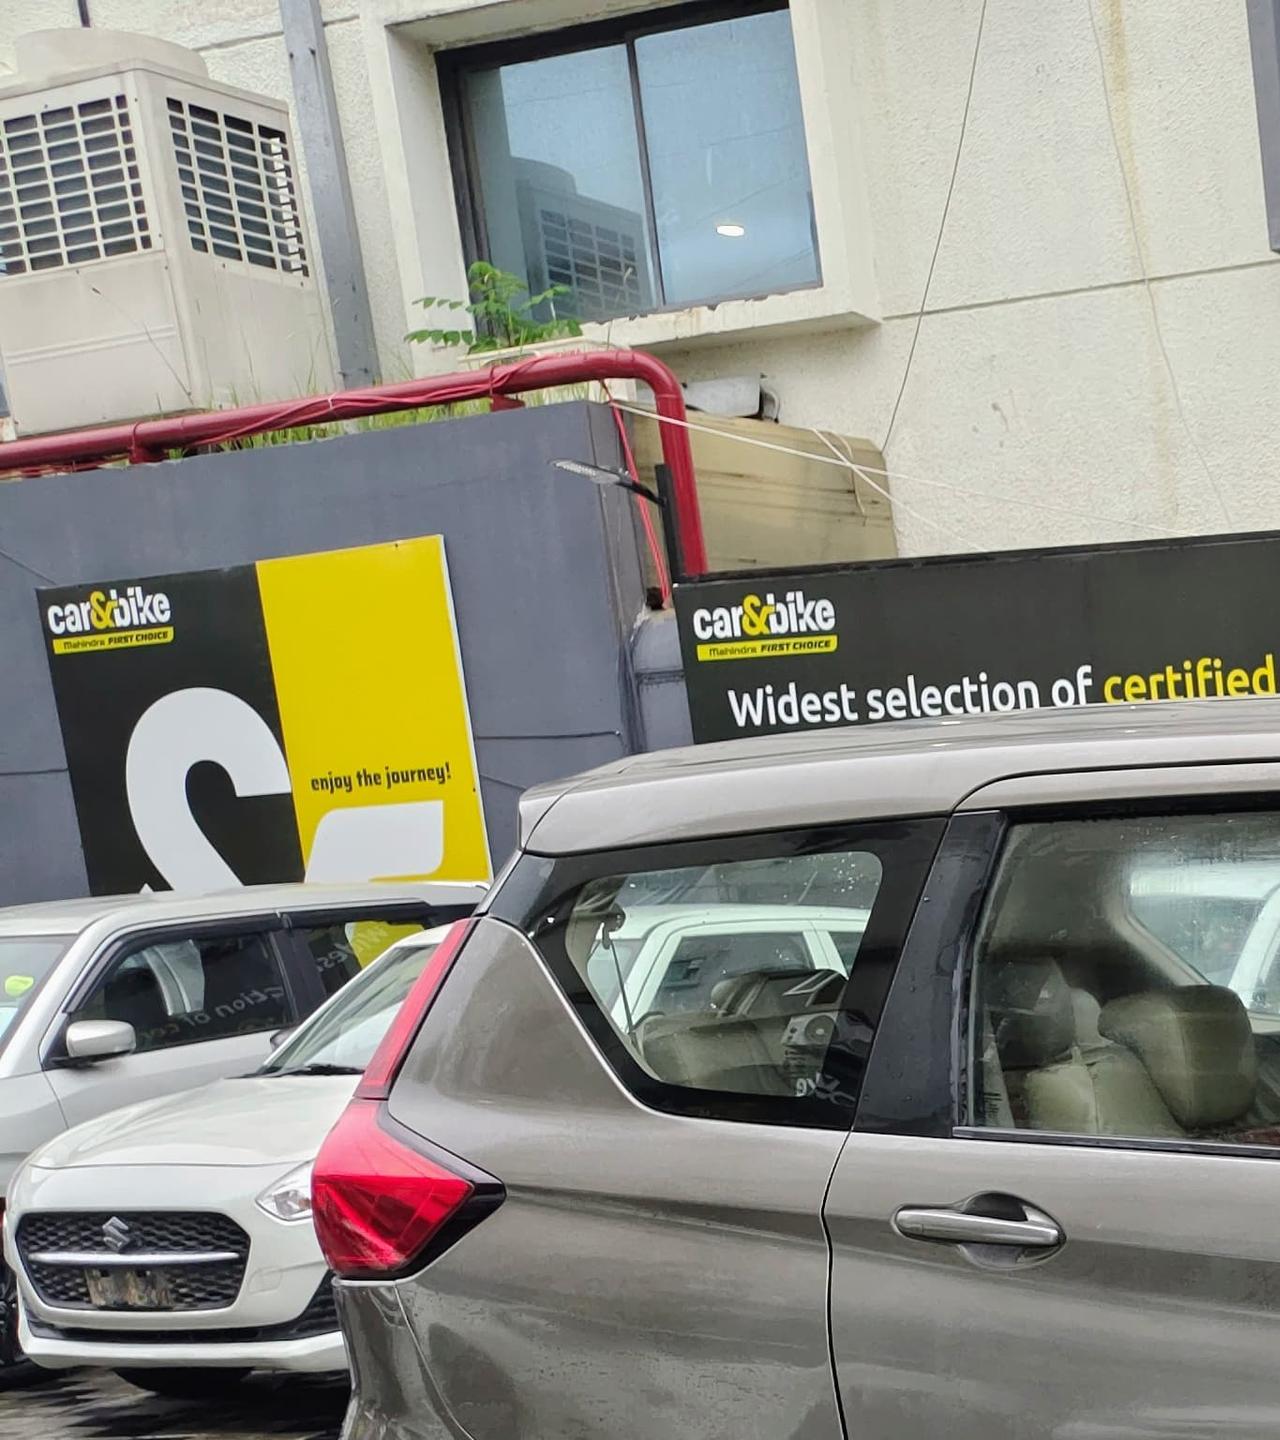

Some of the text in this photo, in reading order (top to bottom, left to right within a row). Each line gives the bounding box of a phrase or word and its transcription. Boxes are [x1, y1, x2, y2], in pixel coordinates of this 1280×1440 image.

[47, 586, 172, 635] car&bike
[693, 590, 836, 640] car&bike
[63, 631, 169, 650] Mahindra FIRST CHOICE
[709, 640, 831, 657] Mahindra FIRST CHOICE
[728, 682, 858, 728] Widest
[866, 672, 1040, 720] selection
[1051, 664, 1093, 707] of
[1104, 653, 1276, 703] certified
[311, 761, 452, 794] enjoy the journey!
